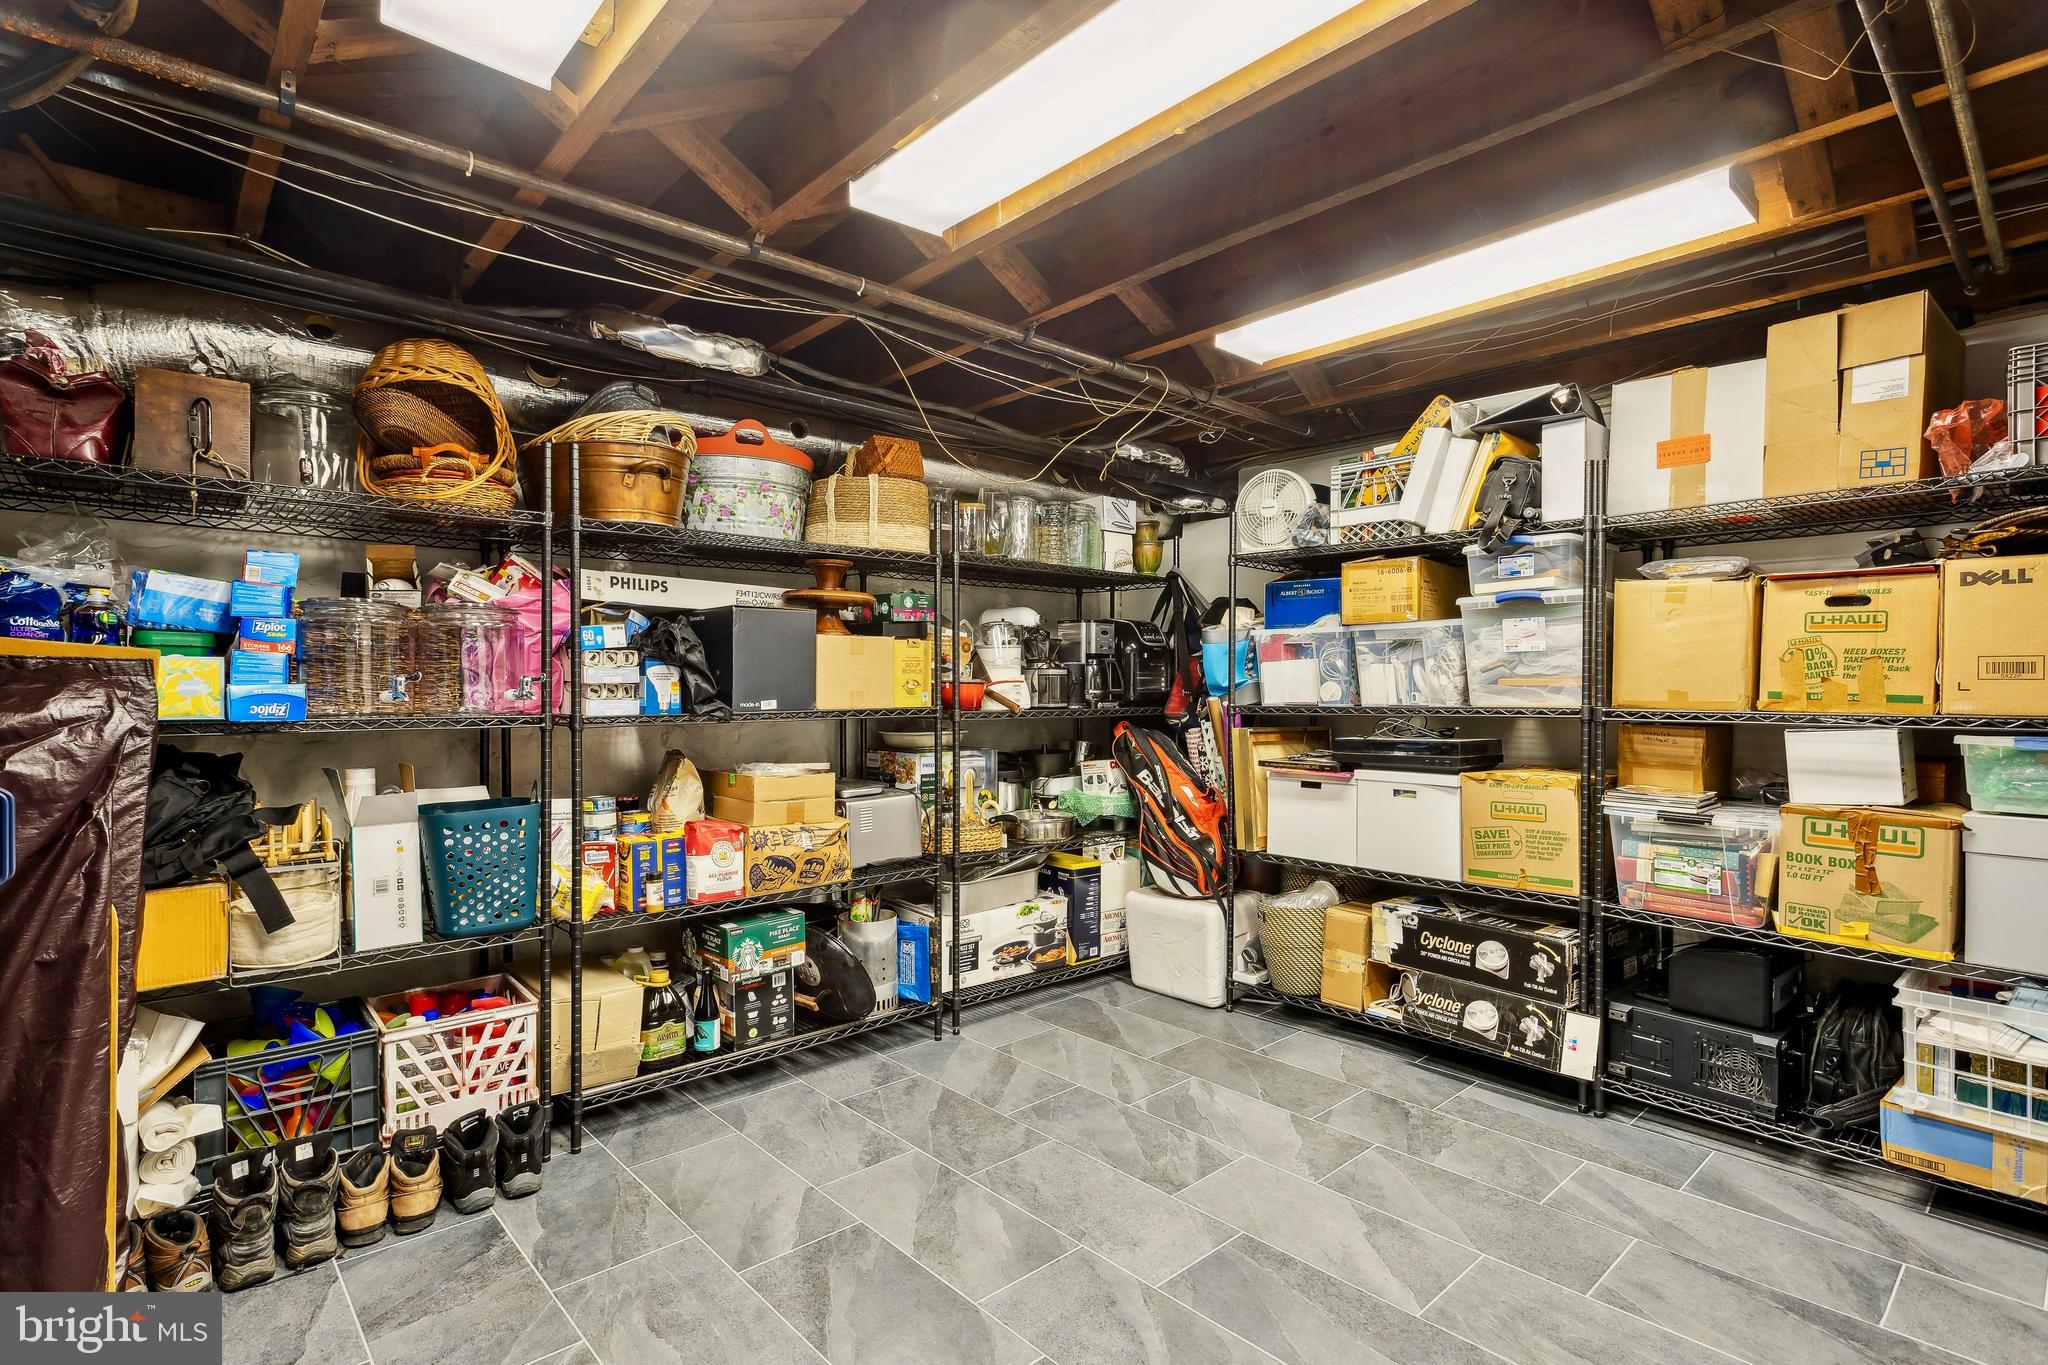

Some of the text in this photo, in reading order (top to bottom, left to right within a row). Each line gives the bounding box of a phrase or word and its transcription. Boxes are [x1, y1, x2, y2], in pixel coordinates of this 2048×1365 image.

[1377, 567, 1412, 576] 16-6006-B
[1960, 568, 2033, 587] DELL
[609, 576, 669, 593] PHILIPS
[1809, 614, 1882, 625] U-HAUL
[254, 620, 288, 634] Ziploc
[582, 629, 595, 641] 60
[277, 643, 293, 651] 166
[1870, 648, 1907, 656] BOXES?
[249, 702, 287, 716] Ziploc
[1493, 804, 1543, 815] U-HAUL
[1474, 829, 1511, 840] SAVE!
[1492, 842, 1511, 850] PRICE
[1786, 851, 1857, 870] BOOK BOX
[708, 870, 739, 879] ALL-PURPOSE
[1801, 917, 1826, 930] OK
[769, 929, 781, 937] PIKE
[783, 924, 801, 934] PLACE
[1420, 931, 1473, 955] Cyclone
[1447, 956, 1471, 967] CIRCULATOR
[731, 974, 741, 983] 72
[1413, 987, 1462, 1014] Cyclone
[2012, 1147, 2024, 1183] Walmart
